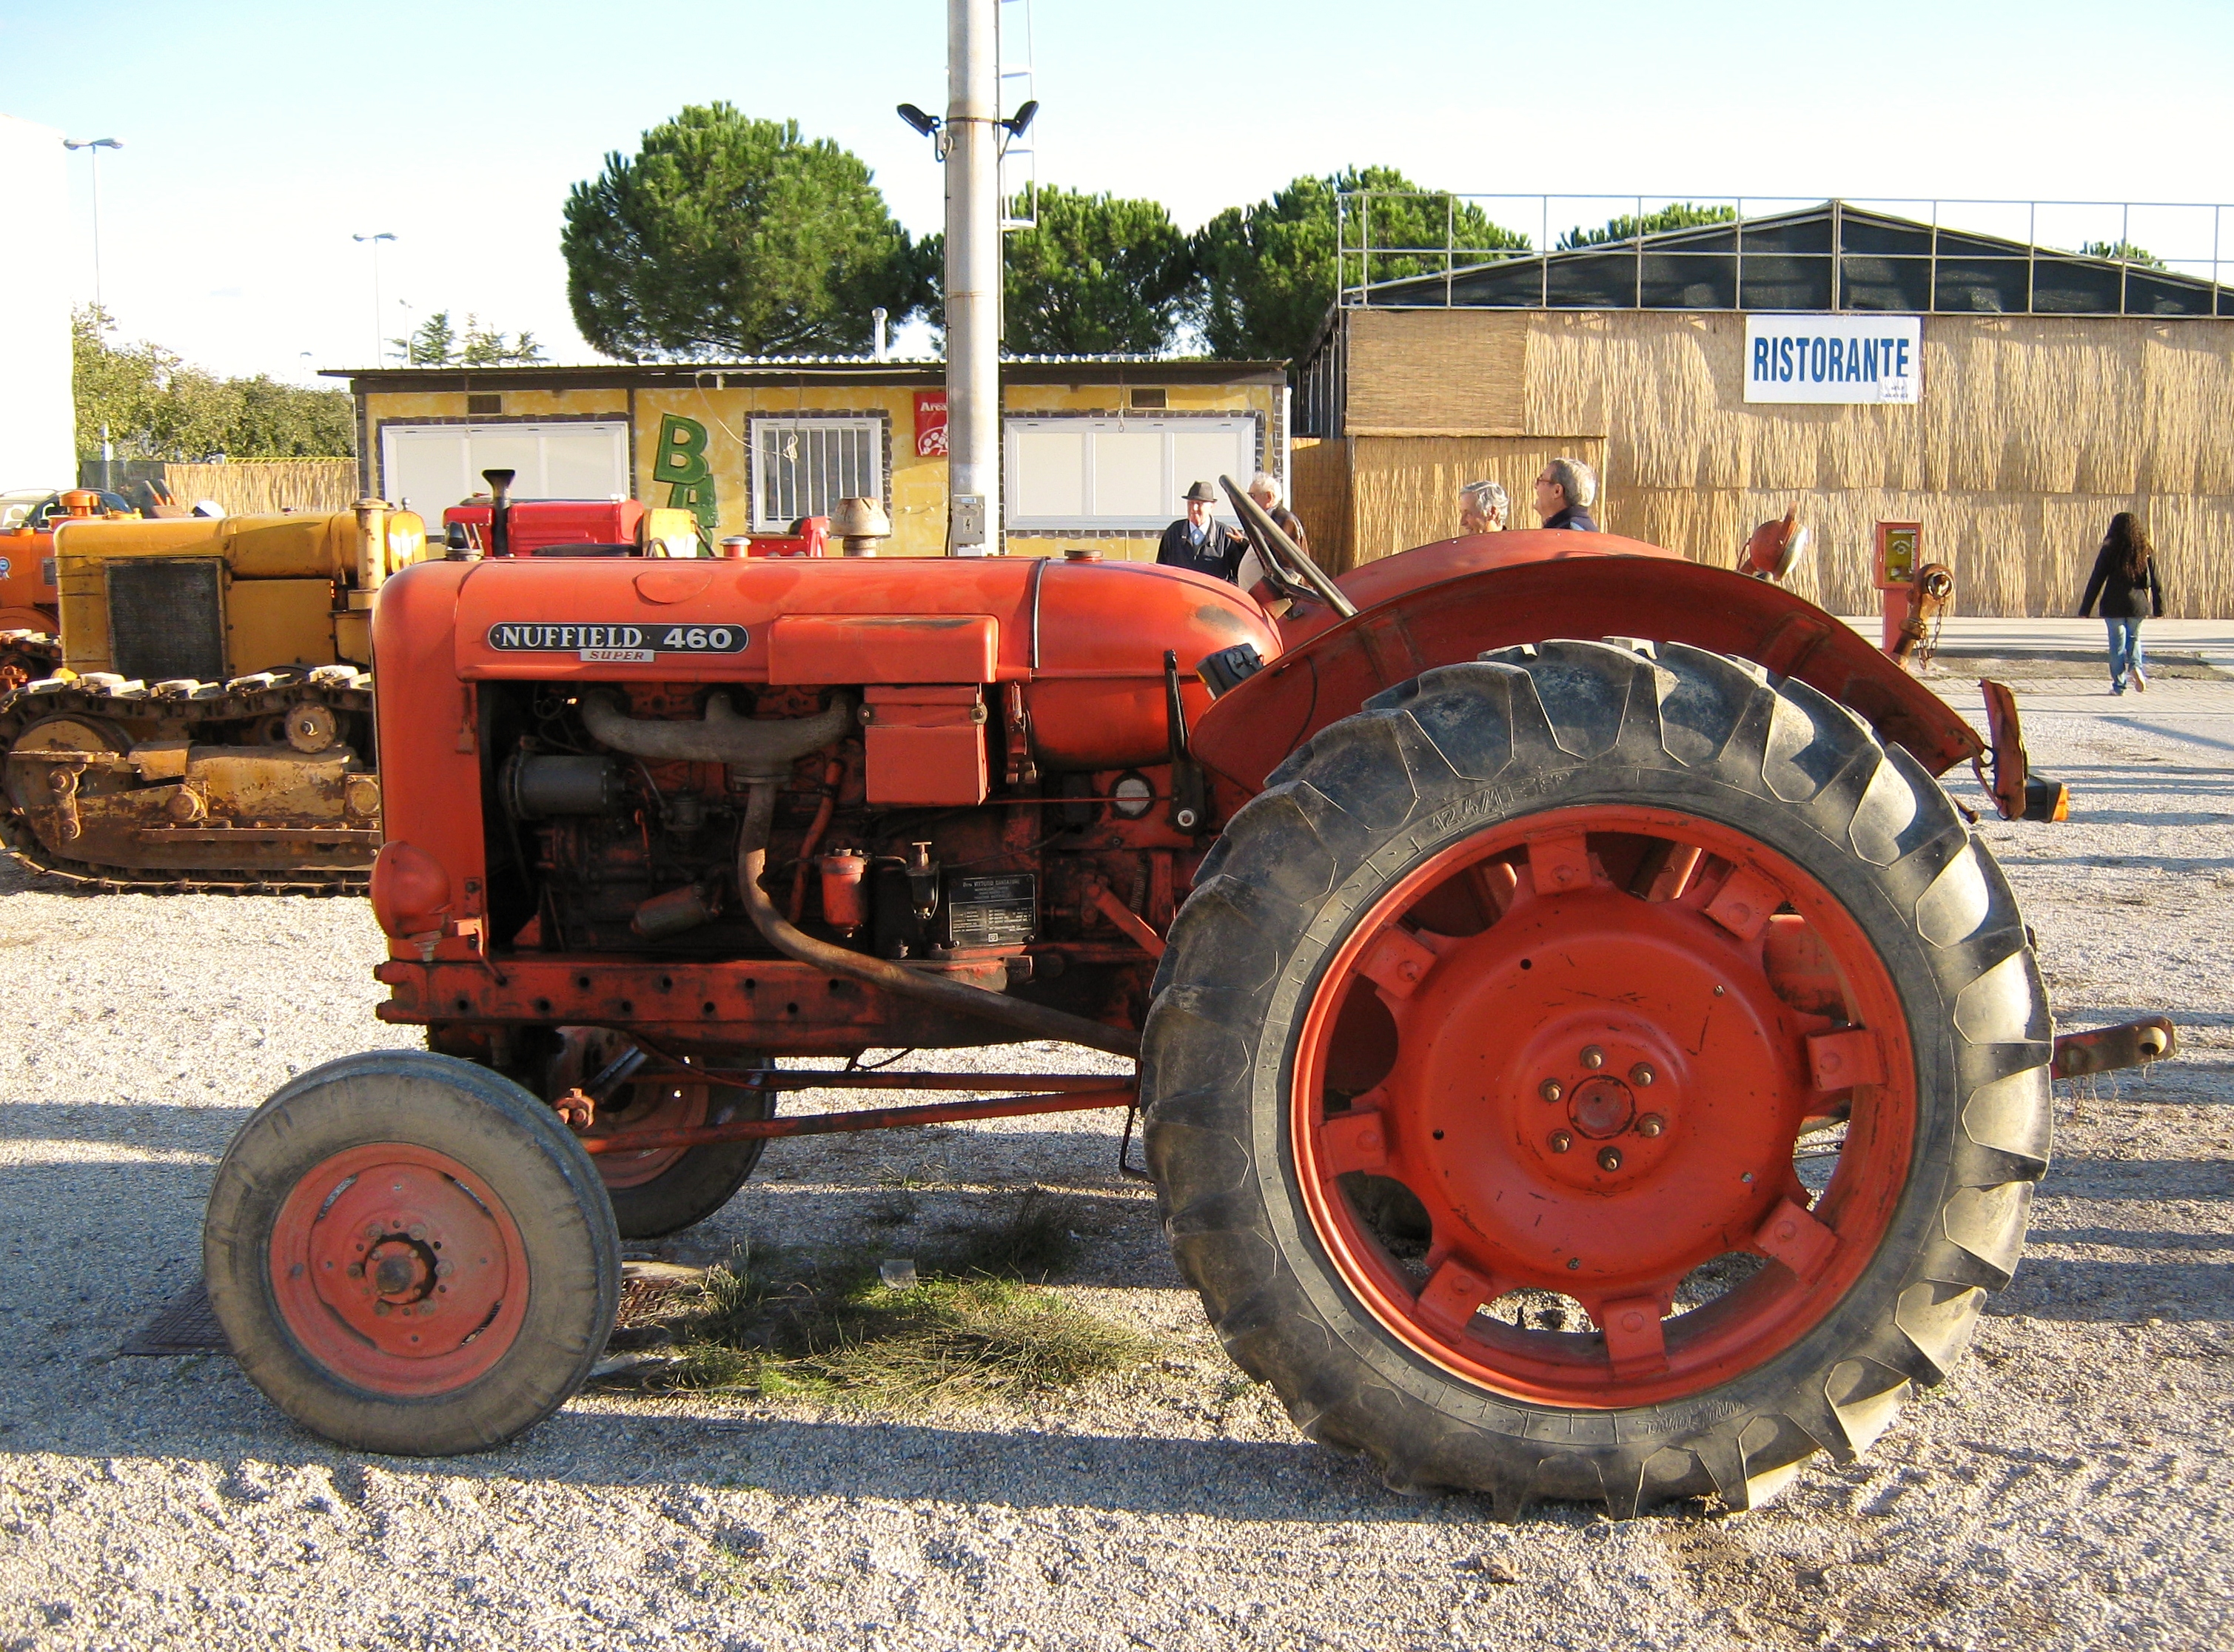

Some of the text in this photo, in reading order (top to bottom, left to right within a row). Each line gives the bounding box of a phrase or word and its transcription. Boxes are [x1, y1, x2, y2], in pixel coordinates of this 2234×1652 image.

[1754, 336, 1910, 382] RISTORANTE
[501, 626, 733, 649] NUFFIELD 460
[588, 650, 645, 661] SUPER
